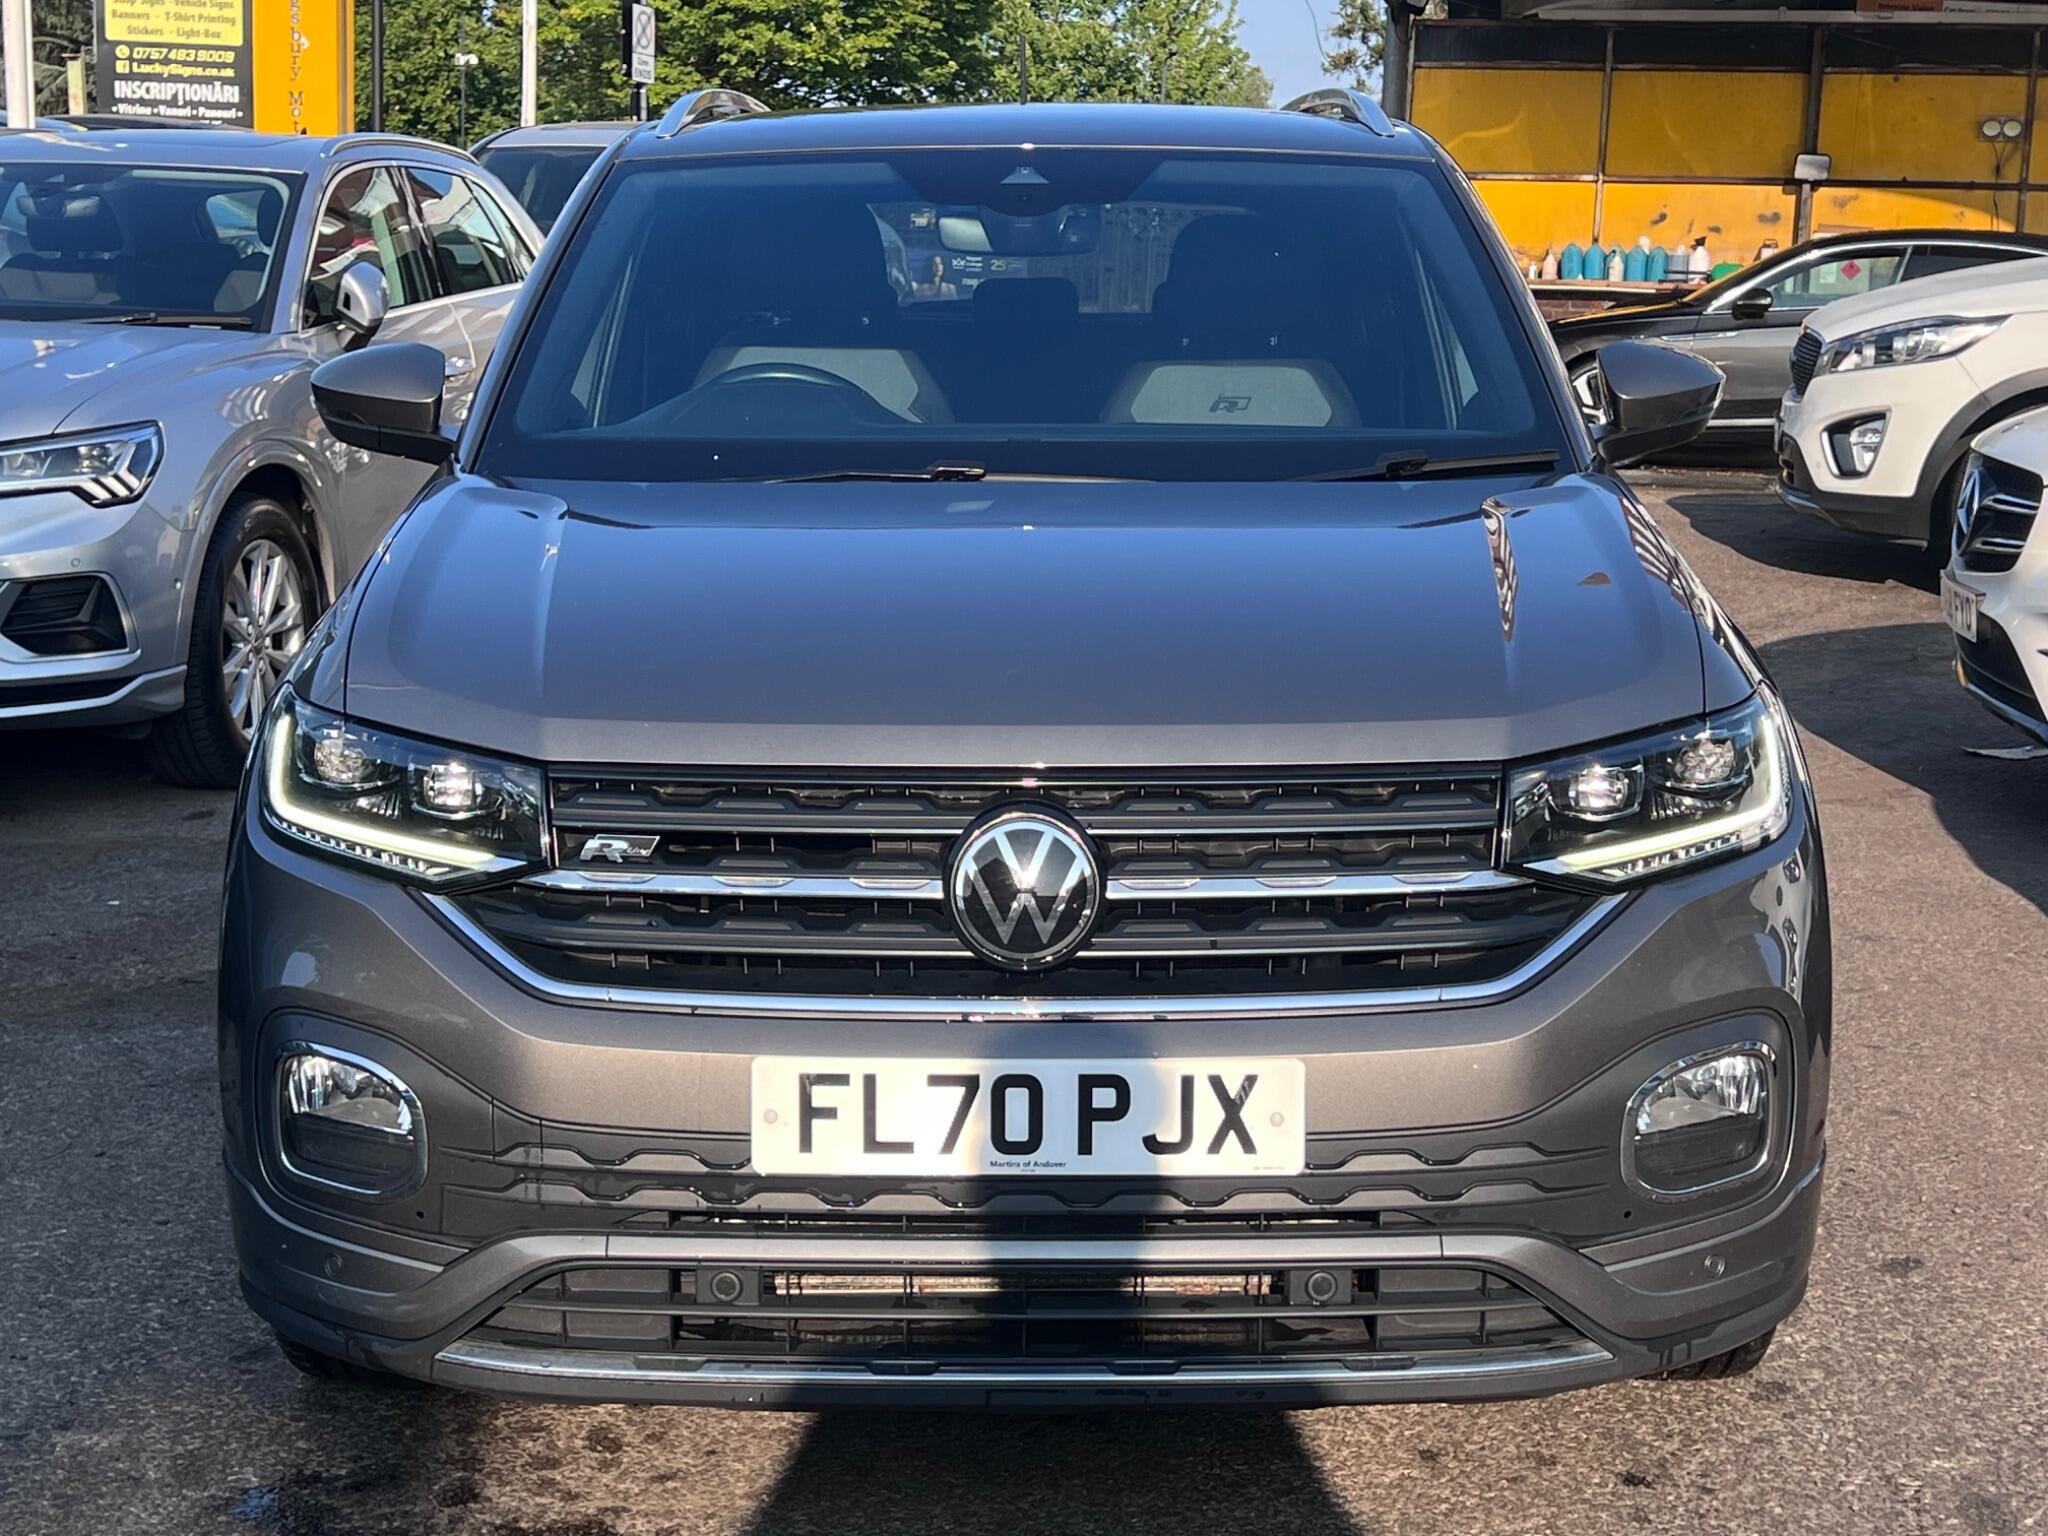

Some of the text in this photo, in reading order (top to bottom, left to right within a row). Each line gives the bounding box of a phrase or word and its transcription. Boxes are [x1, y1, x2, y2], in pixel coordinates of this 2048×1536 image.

[112, 9, 237, 27] Banners T-Shirt Printing
[127, 25, 222, 39] Stickers Light-Box
[132, 47, 168, 59] 0757
[132, 61, 236, 78] LuckySigns.co.uk
[800, 1073, 1258, 1156] FL70 PJX
[990, 1160, 1067, 1168] Martins of Andover
